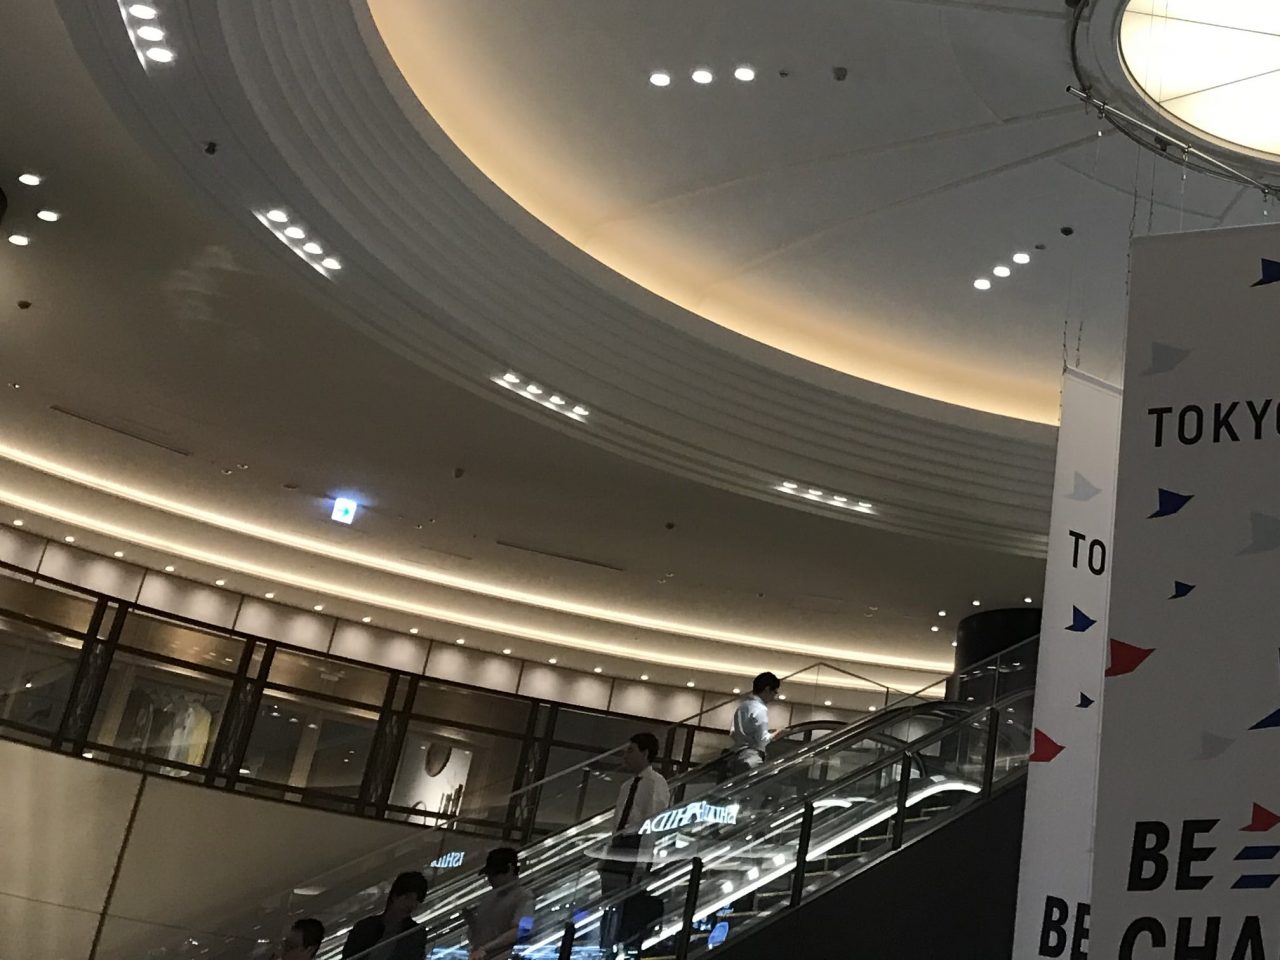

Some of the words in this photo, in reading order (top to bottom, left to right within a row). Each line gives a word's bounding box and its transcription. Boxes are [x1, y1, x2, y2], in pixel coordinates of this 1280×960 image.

[1068, 529, 1107, 576] TO
[1127, 818, 1221, 892] BE
[1038, 895, 1091, 960] BE
